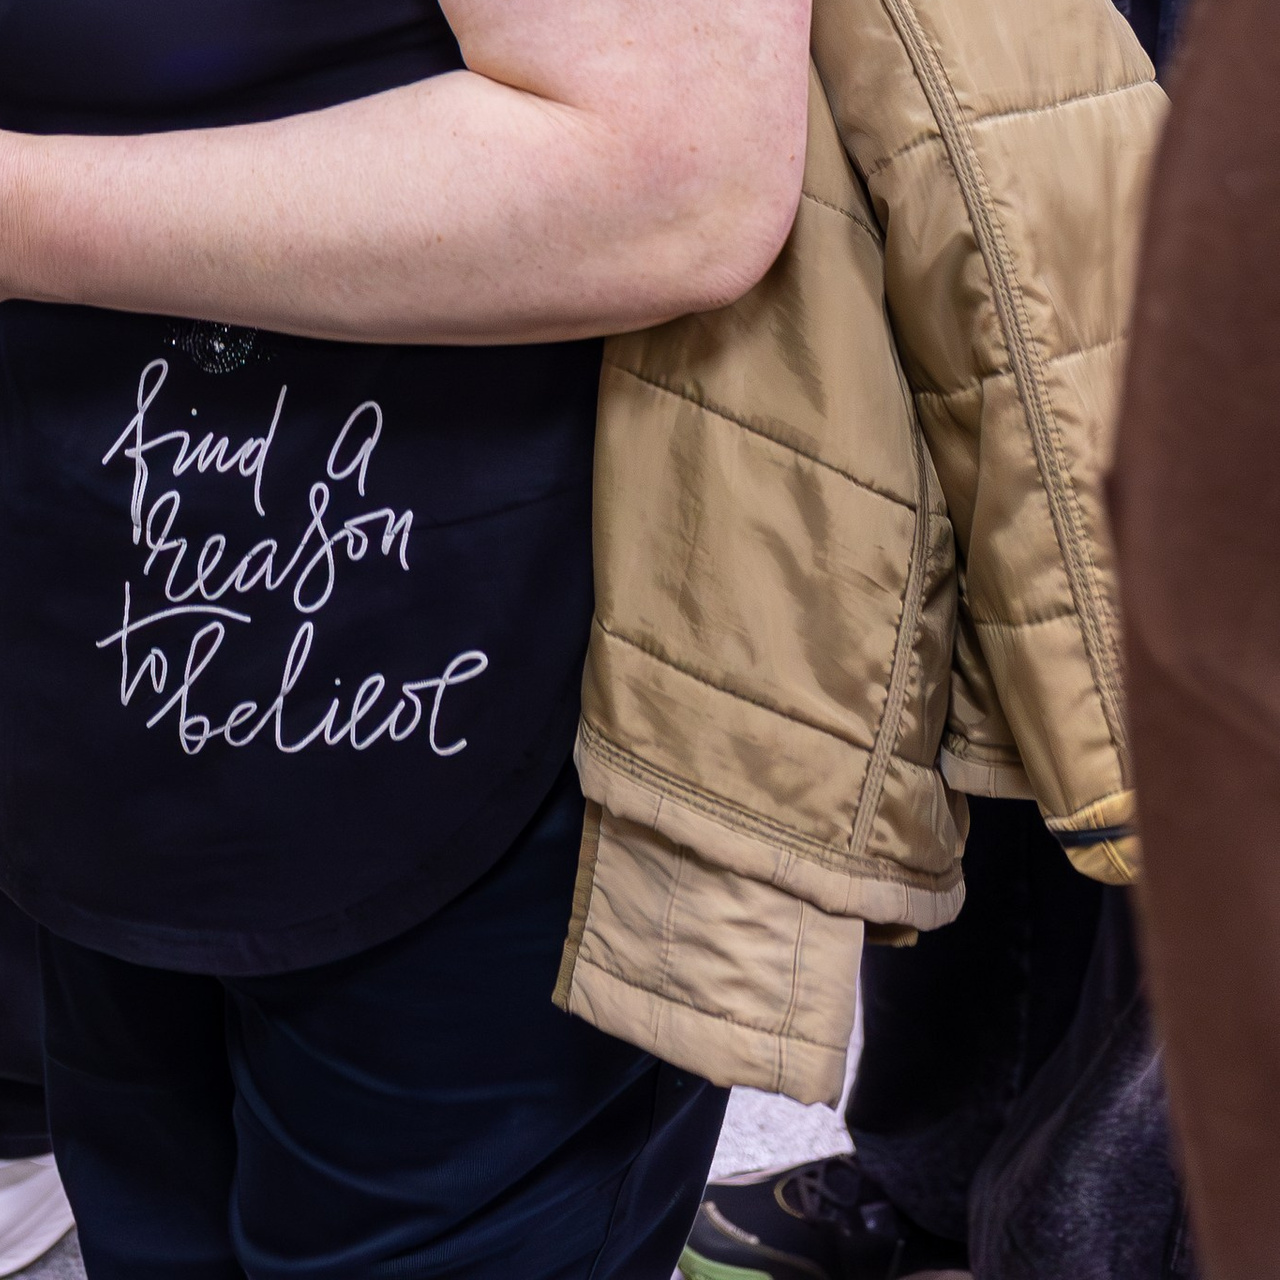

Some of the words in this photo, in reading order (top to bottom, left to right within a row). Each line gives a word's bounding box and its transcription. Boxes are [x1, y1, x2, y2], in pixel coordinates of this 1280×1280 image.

[101, 357, 288, 544] find
[144, 481, 414, 613] reason
[147, 620, 489, 756] believe
